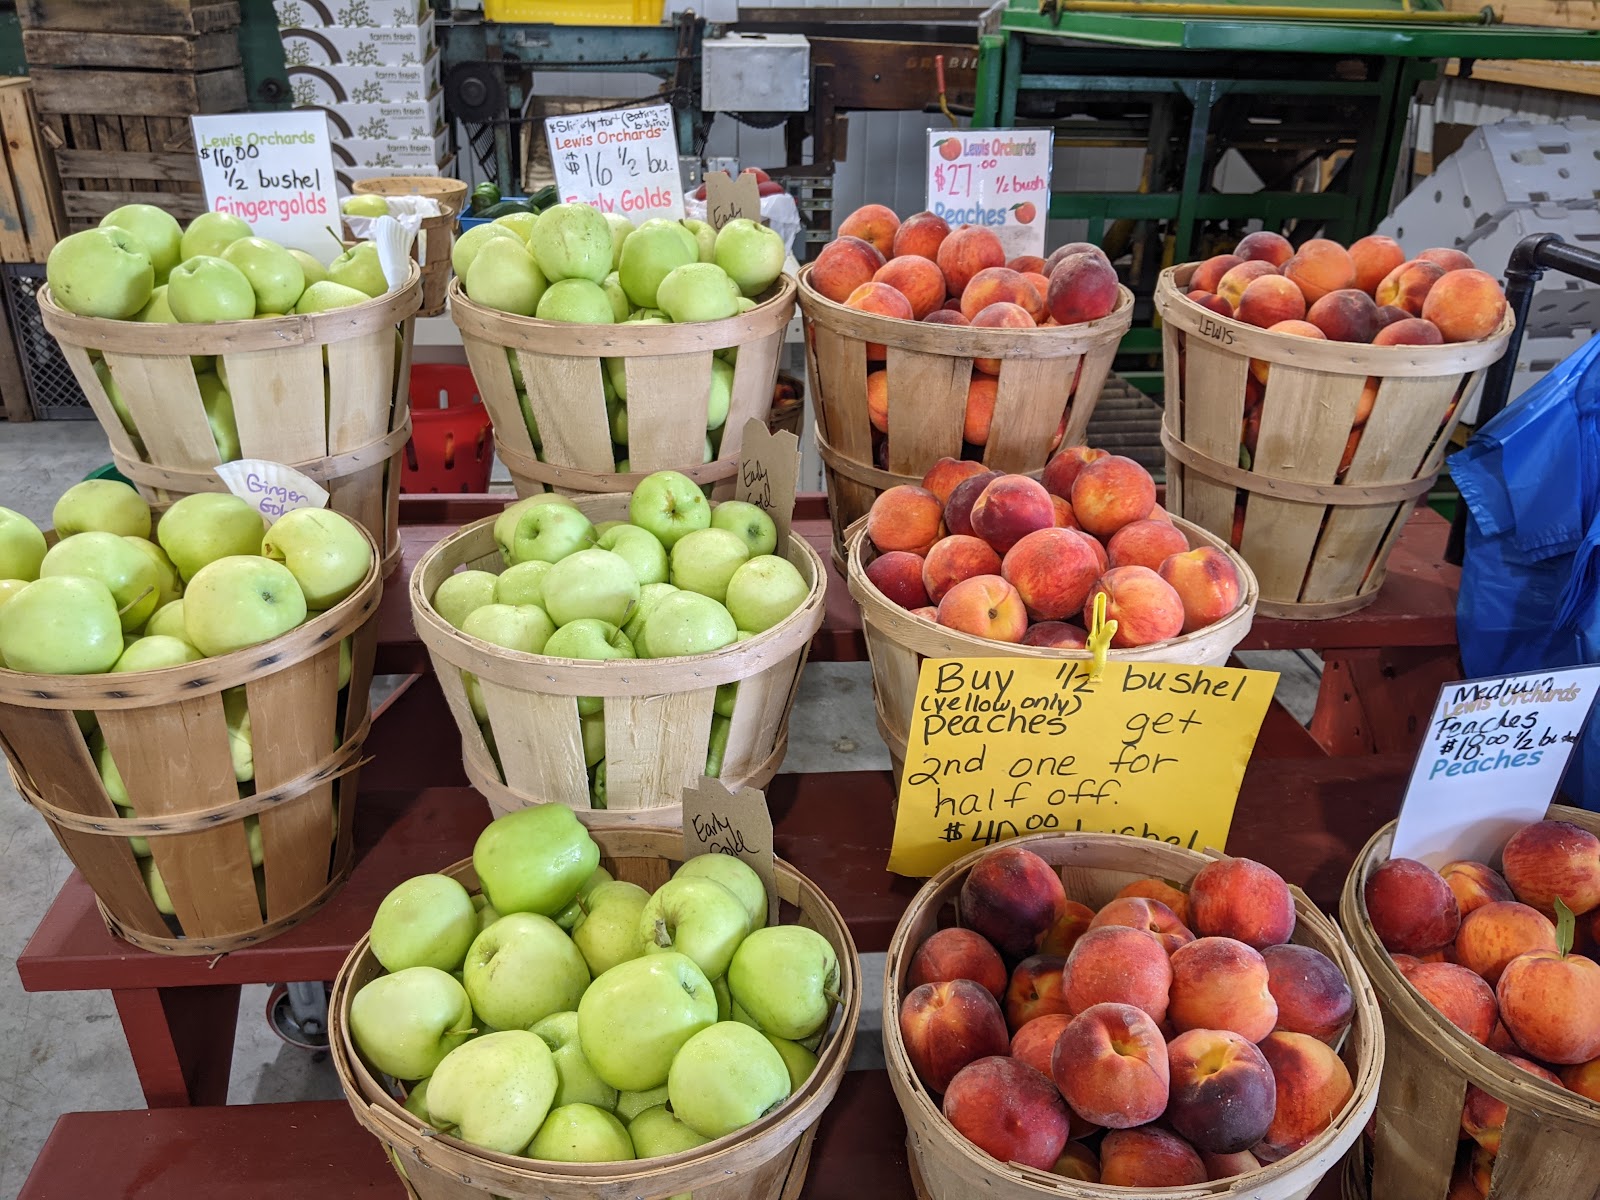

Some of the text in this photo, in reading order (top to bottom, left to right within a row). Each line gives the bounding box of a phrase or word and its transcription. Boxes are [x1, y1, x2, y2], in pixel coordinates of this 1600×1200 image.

[201, 131, 316, 148] Lewis Orchards
[555, 127, 661, 150] Lewis Orchards
[963, 137, 1036, 156] Lewis Orchards
[646, 146, 674, 174] bu.
[258, 168, 321, 191] bushel
[1012, 175, 1046, 193] bush
[214, 191, 328, 223] Gingergolds
[620, 186, 672, 212] Golds
[934, 201, 1007, 226] Peaches
[1198, 314, 1235, 345] LEWIS
[246, 473, 309, 504] Ginger
[935, 662, 1015, 702] Buy
[1122, 664, 1248, 702] bushel
[1020, 692, 1083, 717] only)
[924, 706, 1203, 747] peaches get
[908, 743, 1180, 786] 2nd one for
[1428, 749, 1544, 780] Peaches
[934, 779, 1123, 818] half off.
[691, 812, 739, 844] Early
